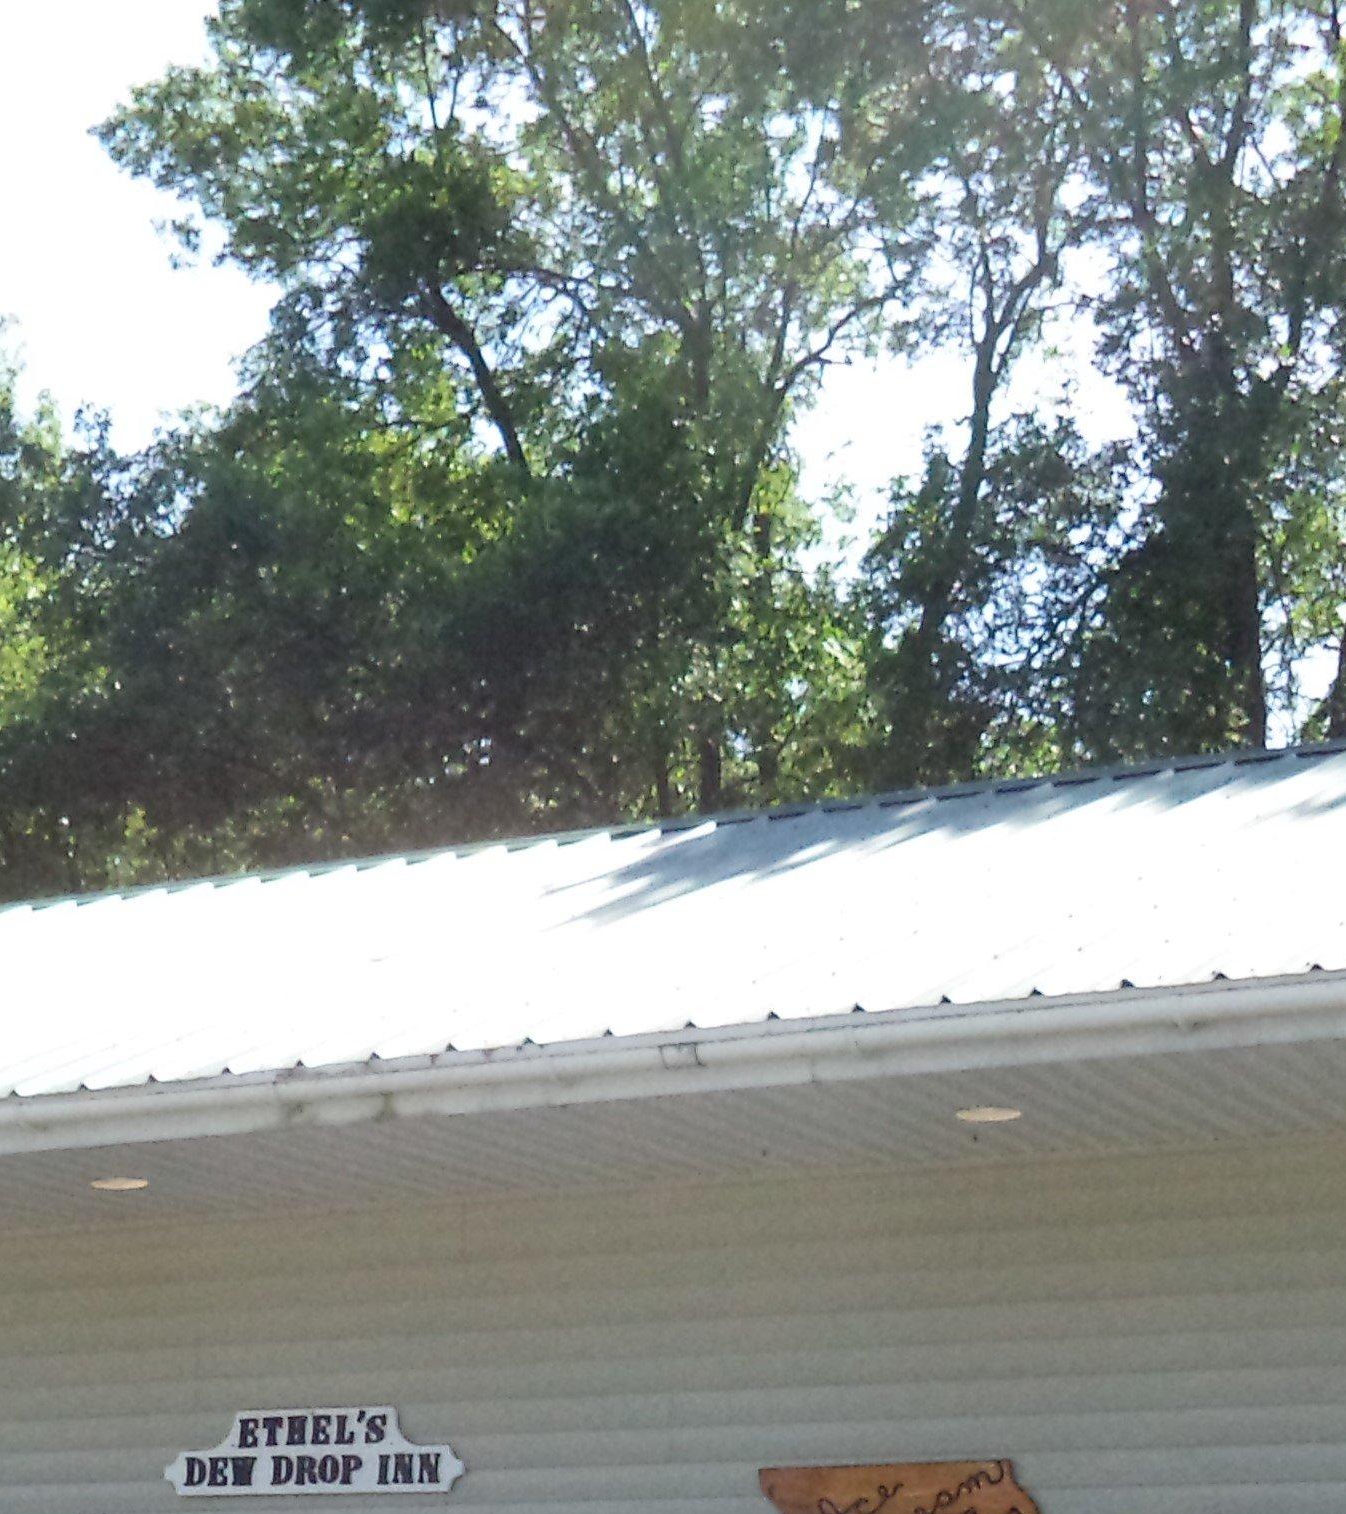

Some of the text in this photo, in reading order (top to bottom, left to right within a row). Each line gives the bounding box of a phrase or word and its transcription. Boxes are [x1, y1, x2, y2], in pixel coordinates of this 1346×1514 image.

[238, 1411, 387, 1448] ETHEL'S
[183, 1453, 441, 1486] DEW DROP INN
